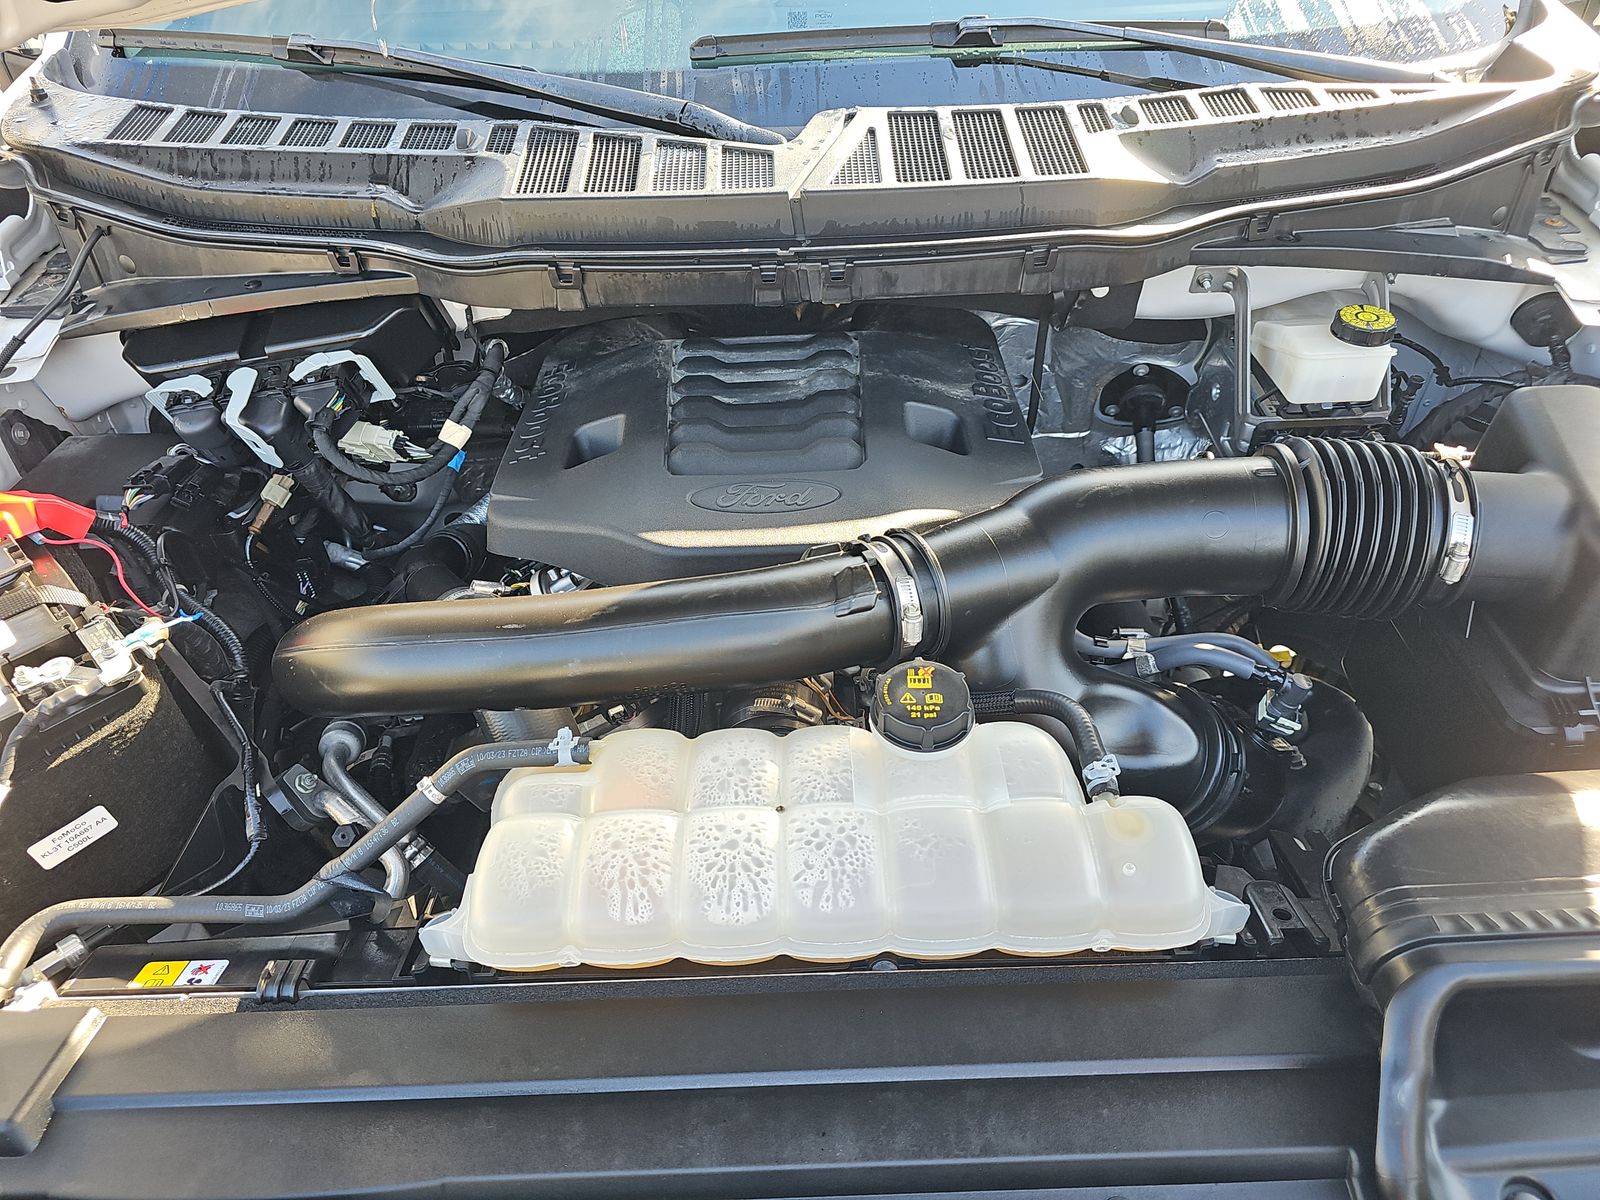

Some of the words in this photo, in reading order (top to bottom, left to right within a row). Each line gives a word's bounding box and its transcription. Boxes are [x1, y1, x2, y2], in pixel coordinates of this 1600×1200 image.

[716, 482, 815, 508] Ford
[923, 711, 937, 719] psi
[476, 750, 506, 763] 10/03/23
[40, 843, 63, 859] KL3T
[95, 816, 108, 826] AA
[51, 821, 87, 844] FoMoCo
[67, 835, 94, 852] C500L
[266, 902, 292, 914] 10/03/23
